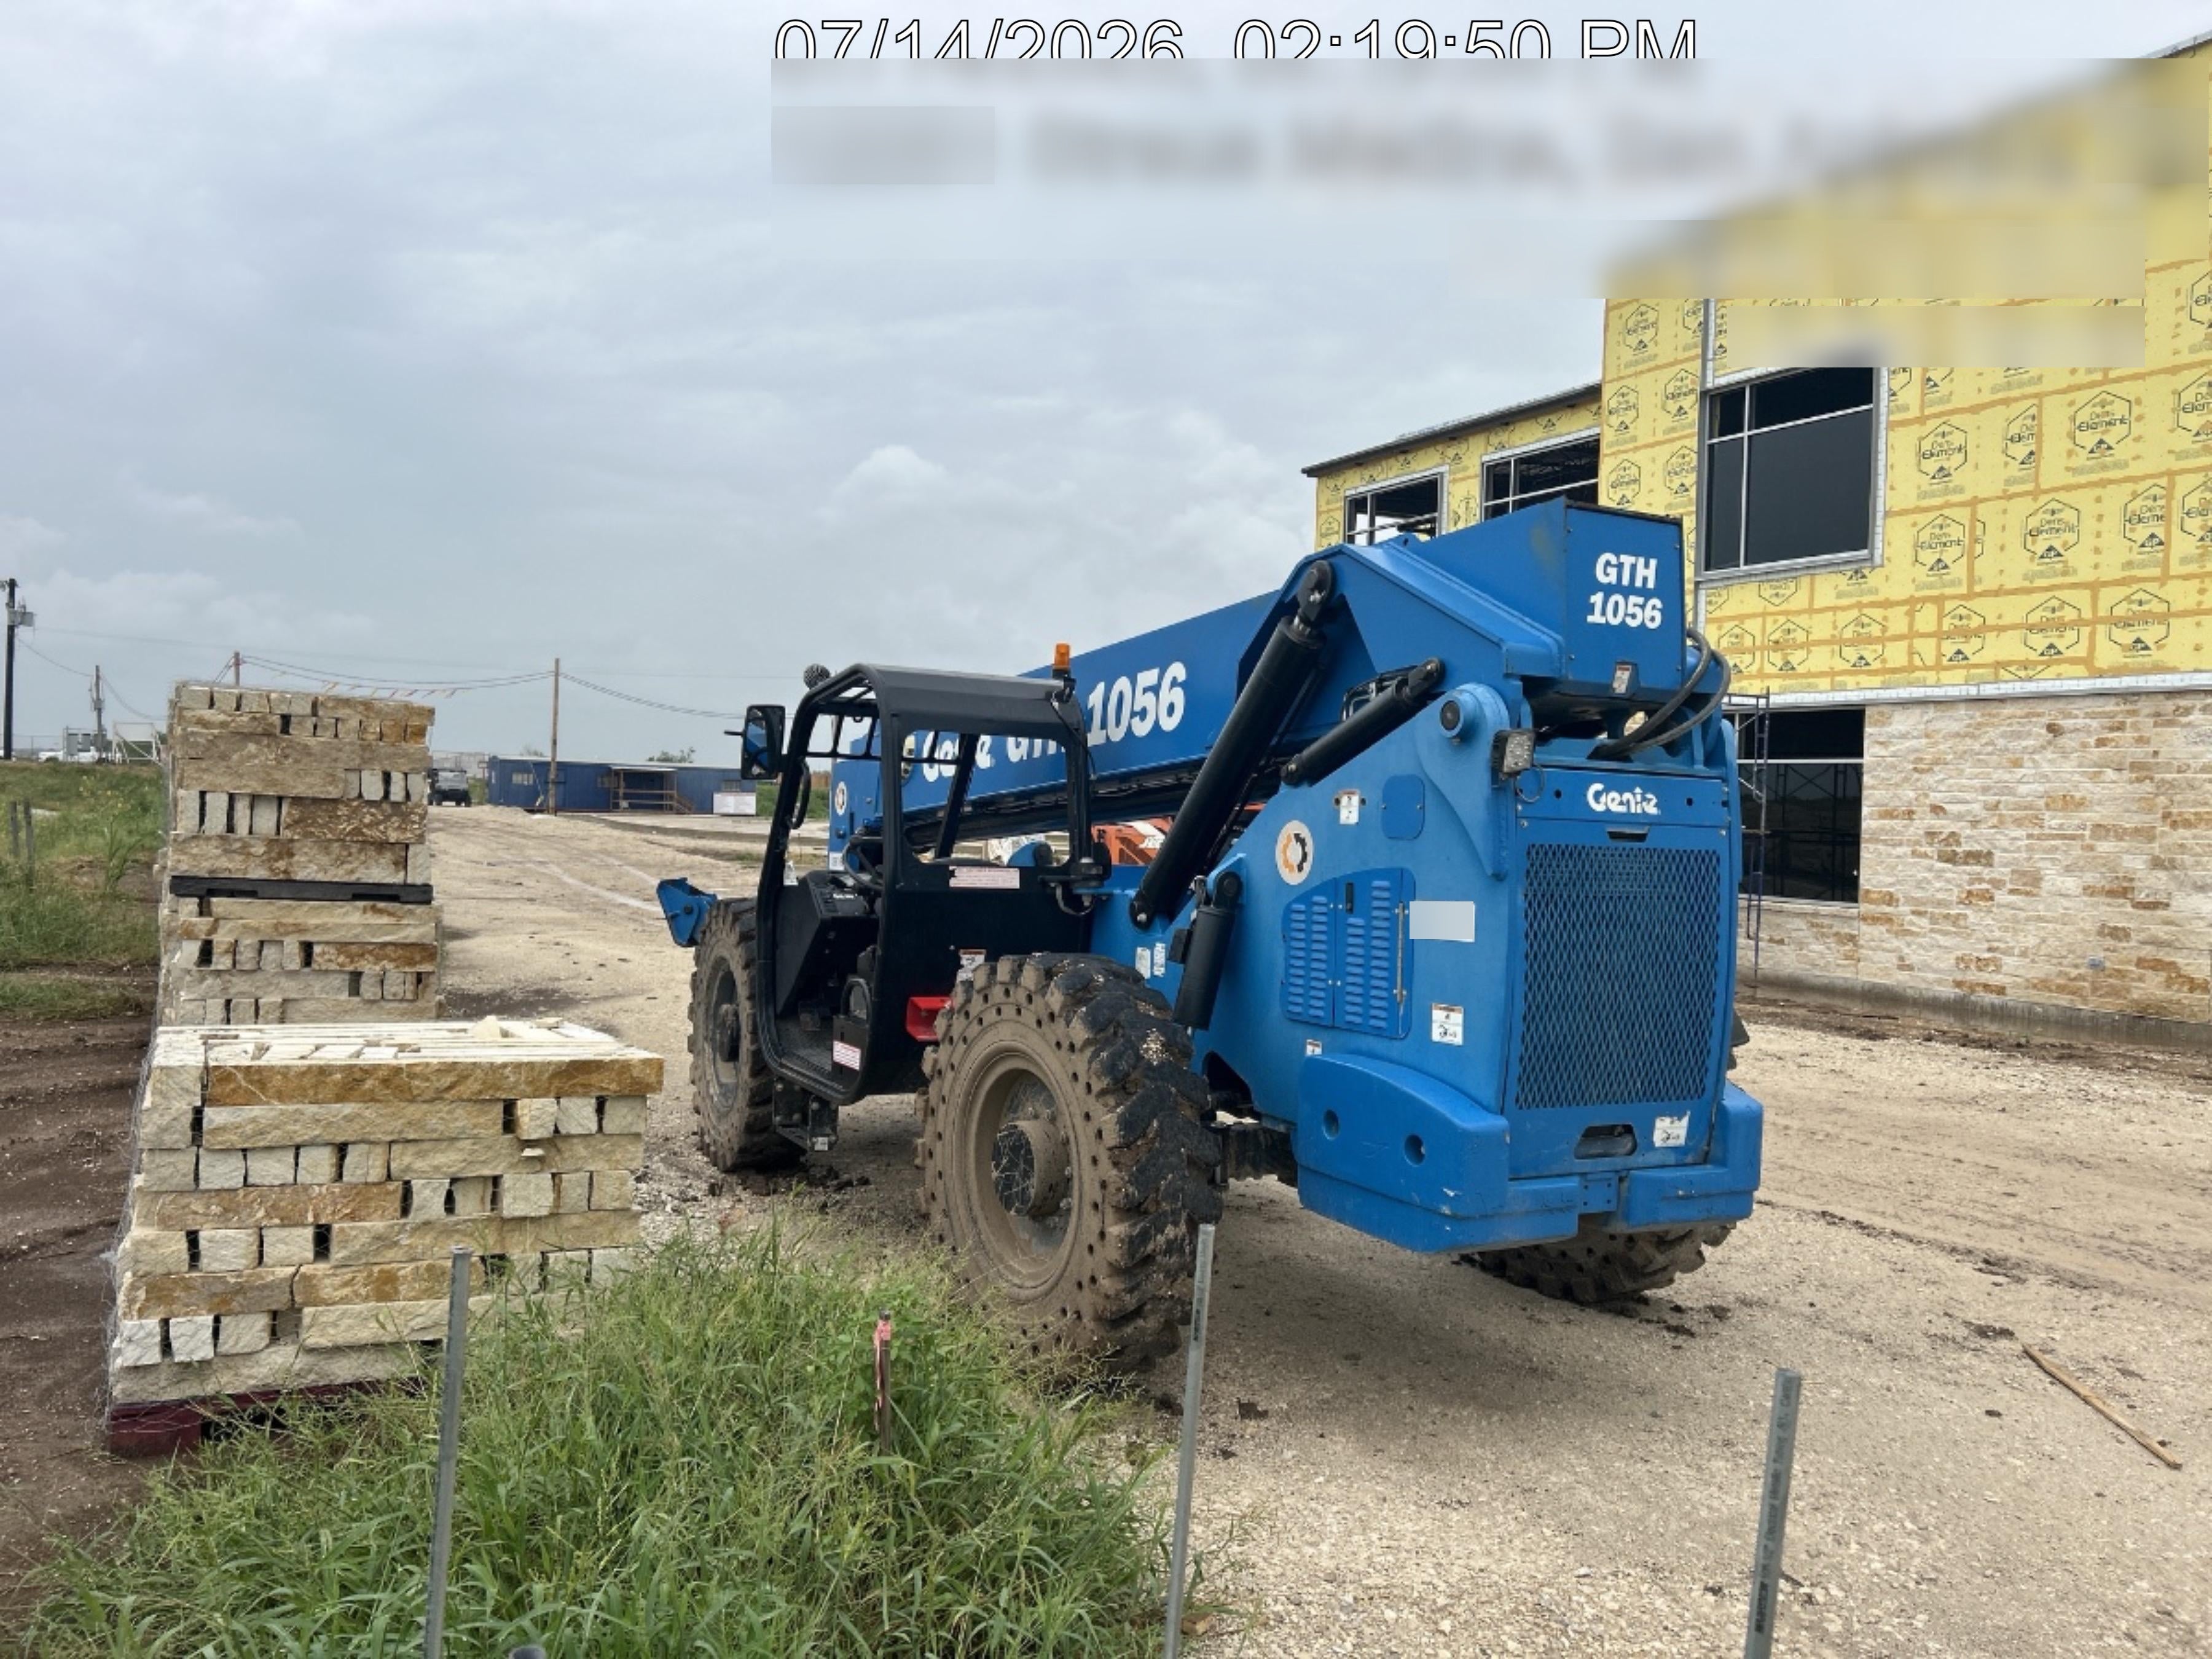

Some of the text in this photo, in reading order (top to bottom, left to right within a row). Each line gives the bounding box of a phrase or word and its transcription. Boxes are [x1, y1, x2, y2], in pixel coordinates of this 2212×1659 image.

[1596, 552, 1658, 589] GTH
[1586, 591, 1663, 629] 1056
[1086, 661, 1186, 747] 1056
[1587, 782, 1661, 815] Genie
